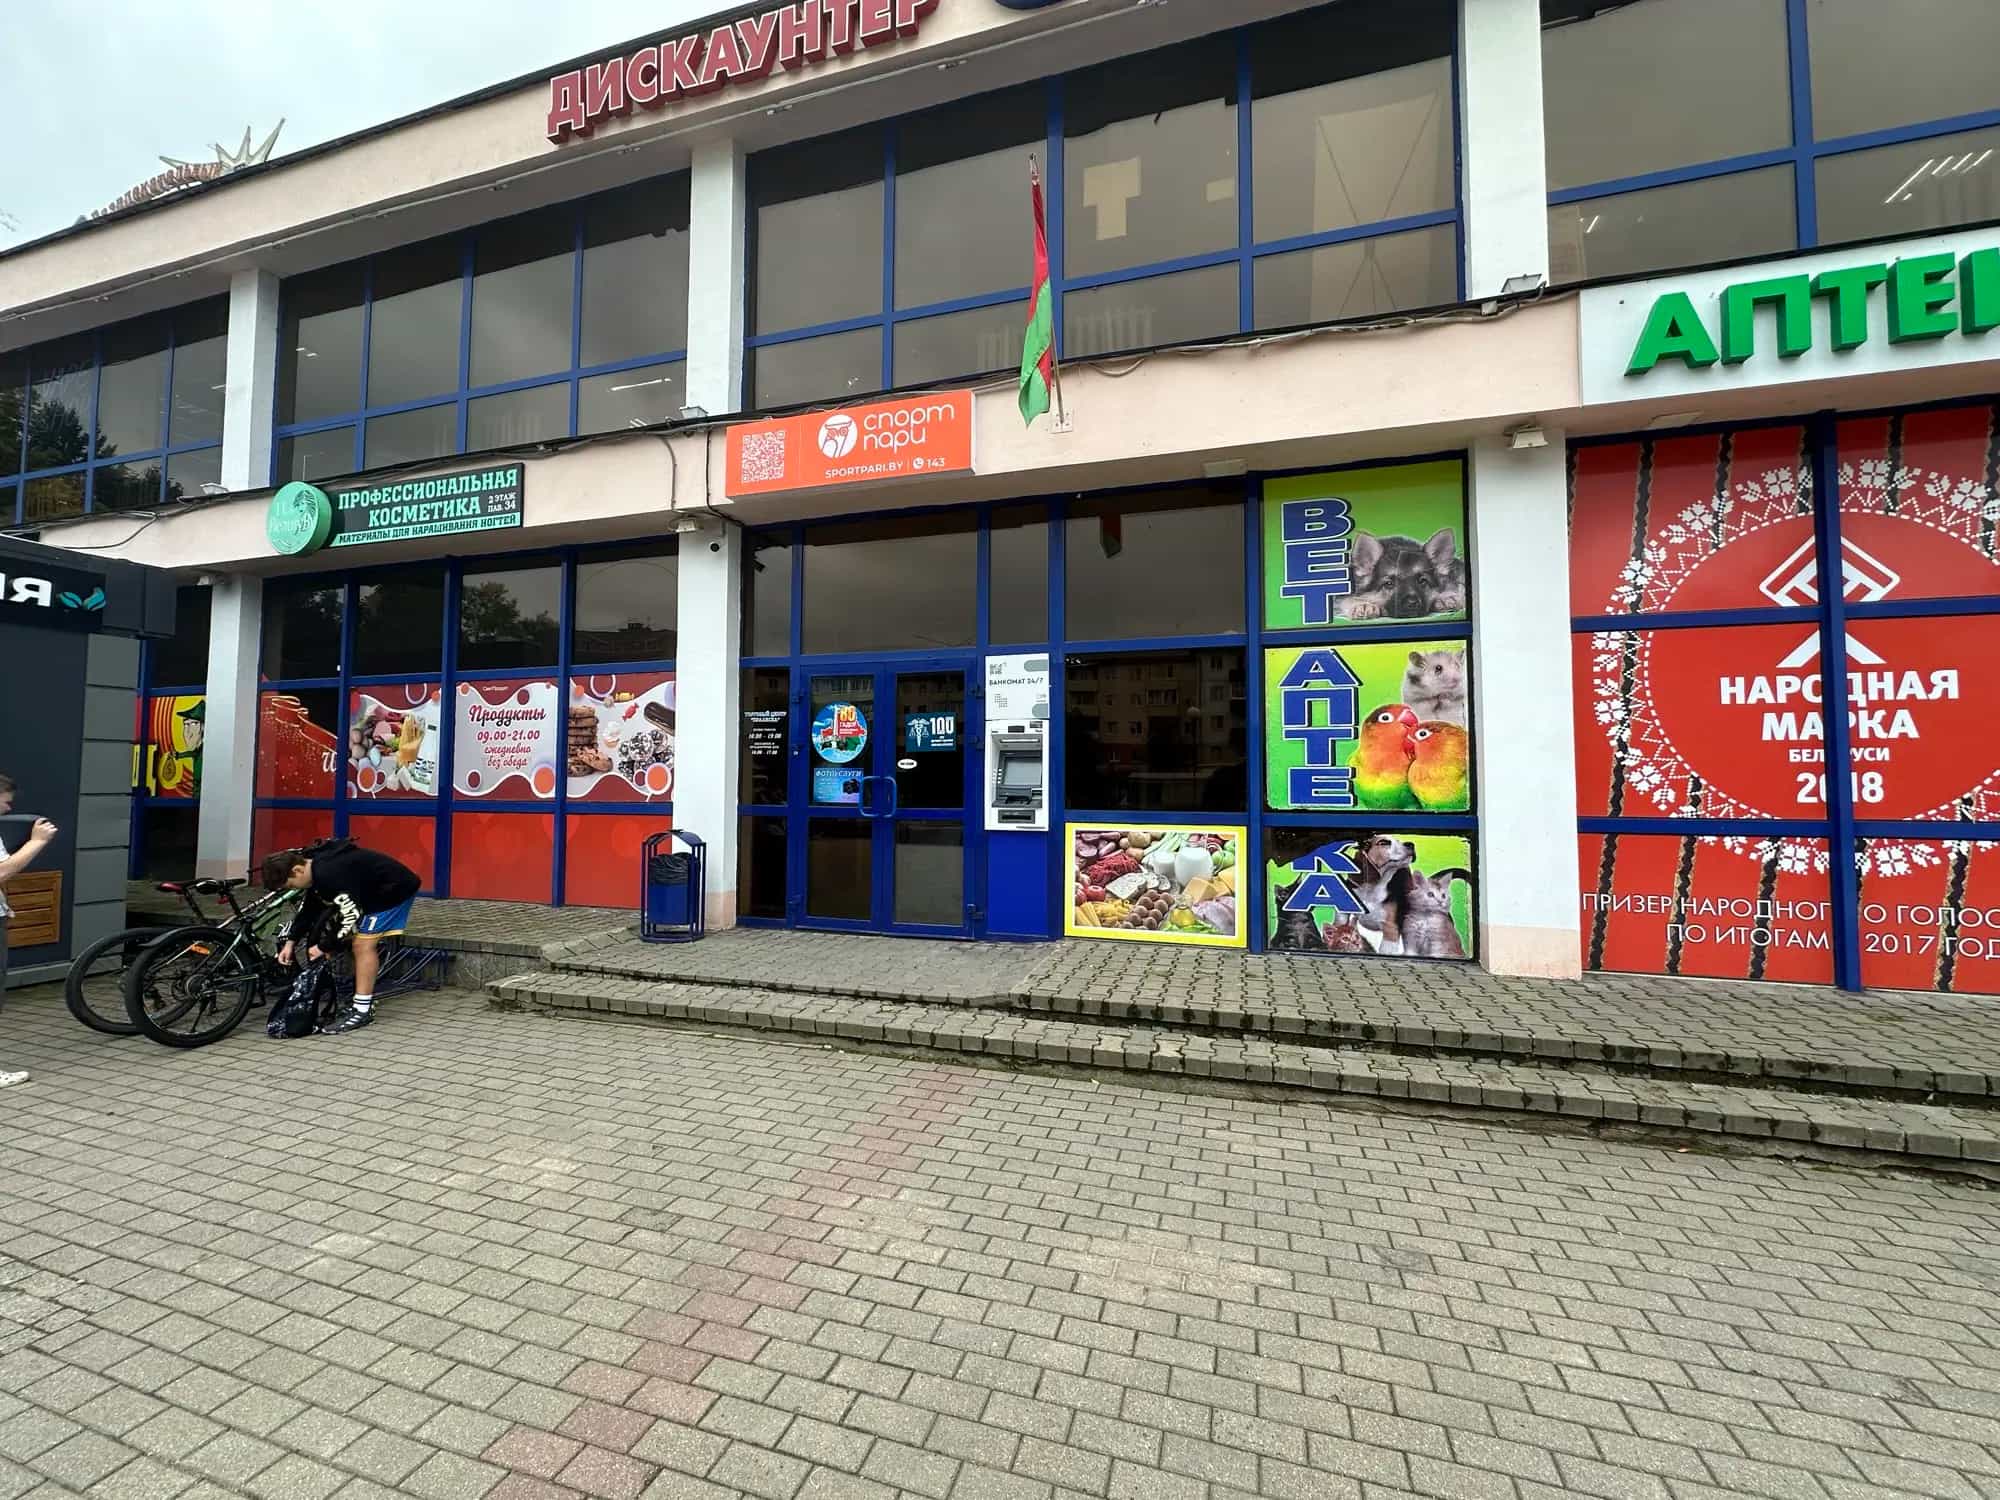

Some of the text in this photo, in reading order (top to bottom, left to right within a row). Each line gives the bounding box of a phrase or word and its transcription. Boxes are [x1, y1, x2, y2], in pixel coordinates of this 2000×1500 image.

[863, 427, 926, 454] пари
[825, 458, 945, 479] SPORTPARI.BY 143
[338, 469, 518, 510] ПРОФЕССИОНАЛЬНАЯ
[368, 496, 481, 528] КОСМЕТИКА
[504, 500, 516, 510] 34
[339, 514, 516, 544] МАТЕРИАЛЫ ДЛЯ НАРАЩИВАНИЯ НОГТЕЙ
[1719, 669, 1960, 707] НАРОДНАЯ
[469, 704, 546, 727] Продукты
[477, 730, 541, 744] 09.00-21.00
[484, 743, 531, 757] ежедневно
[1788, 746, 1890, 762] БЕЛУСИ
[487, 756, 501, 770] без
[1796, 771, 1884, 803] 218
[1582, 892, 1672, 914] ПРИЗЕР
[1666, 924, 1707, 943] ПО
[1715, 925, 1830, 950] ИТОГАМ
[1864, 933, 1936, 954] 2017
